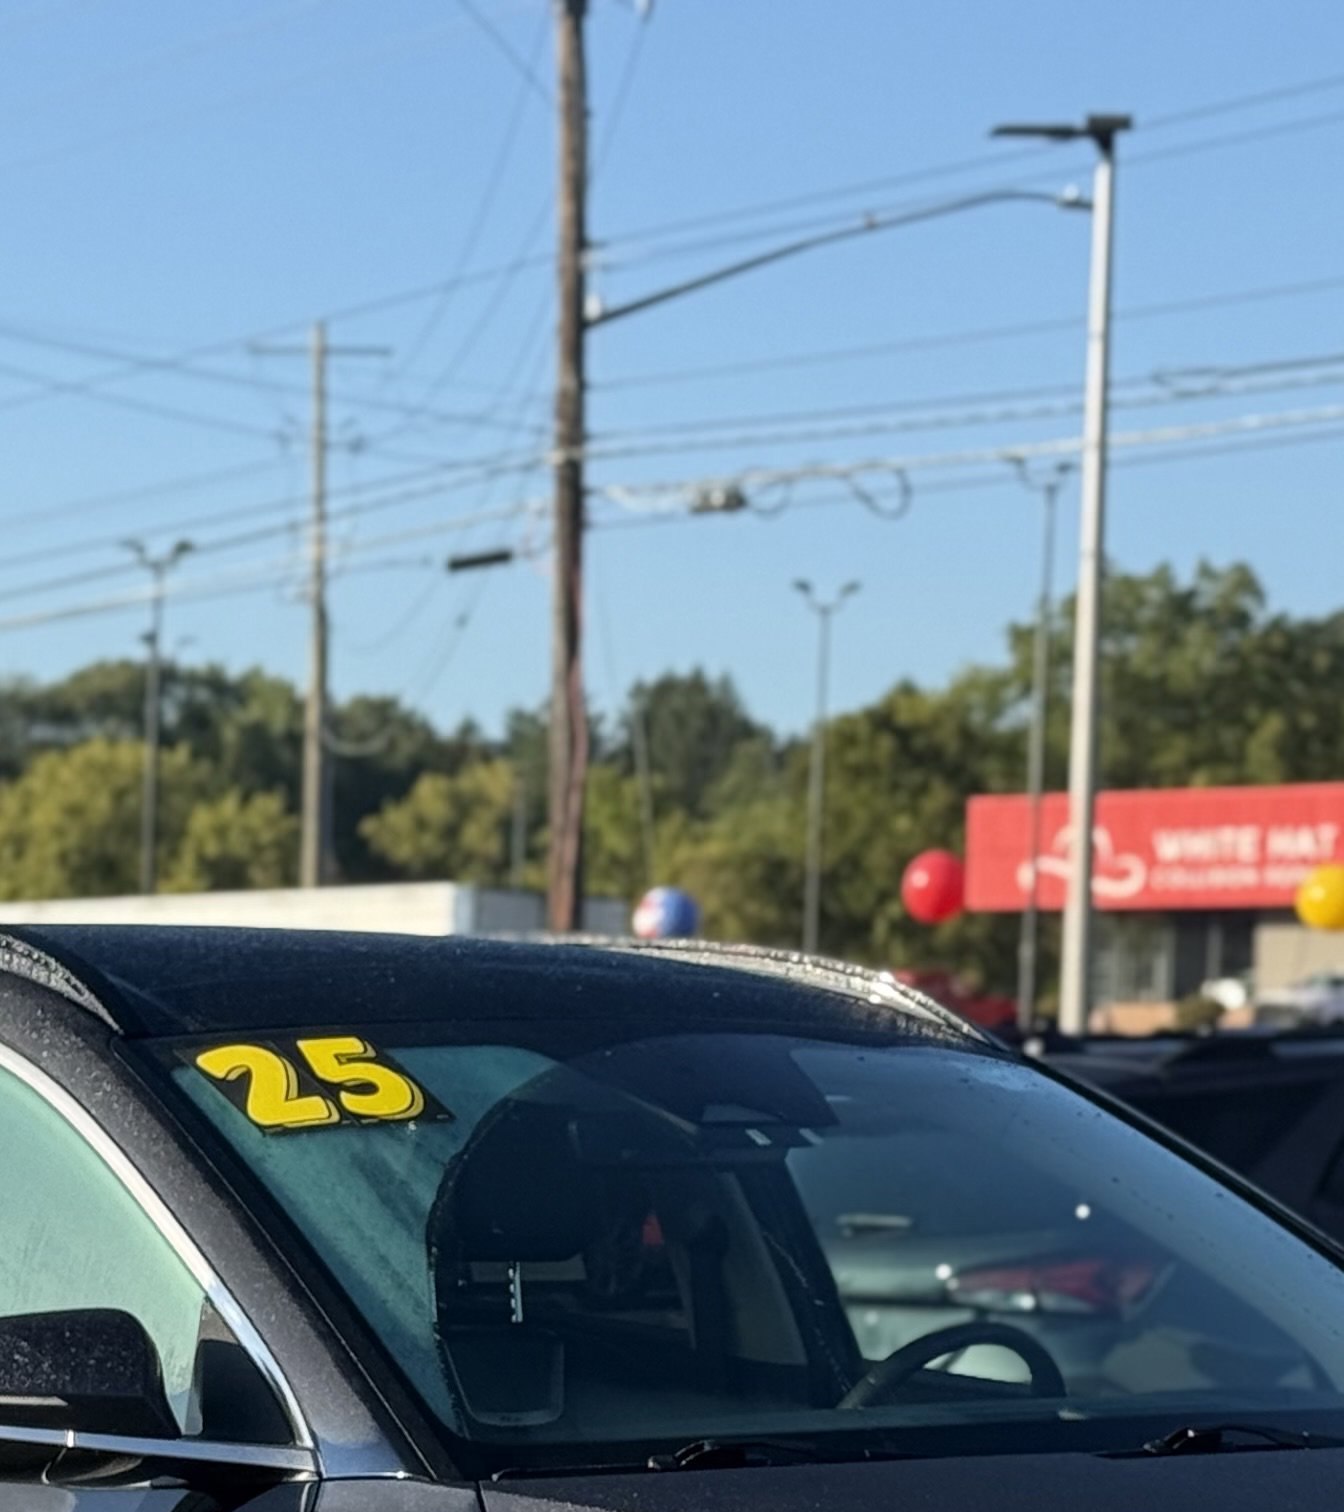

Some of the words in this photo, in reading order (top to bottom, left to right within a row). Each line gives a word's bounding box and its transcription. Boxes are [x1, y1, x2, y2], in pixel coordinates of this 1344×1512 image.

[1153, 826, 1260, 864] WHITE
[1267, 822, 1339, 861] HAT
[196, 1036, 425, 1129] 25
